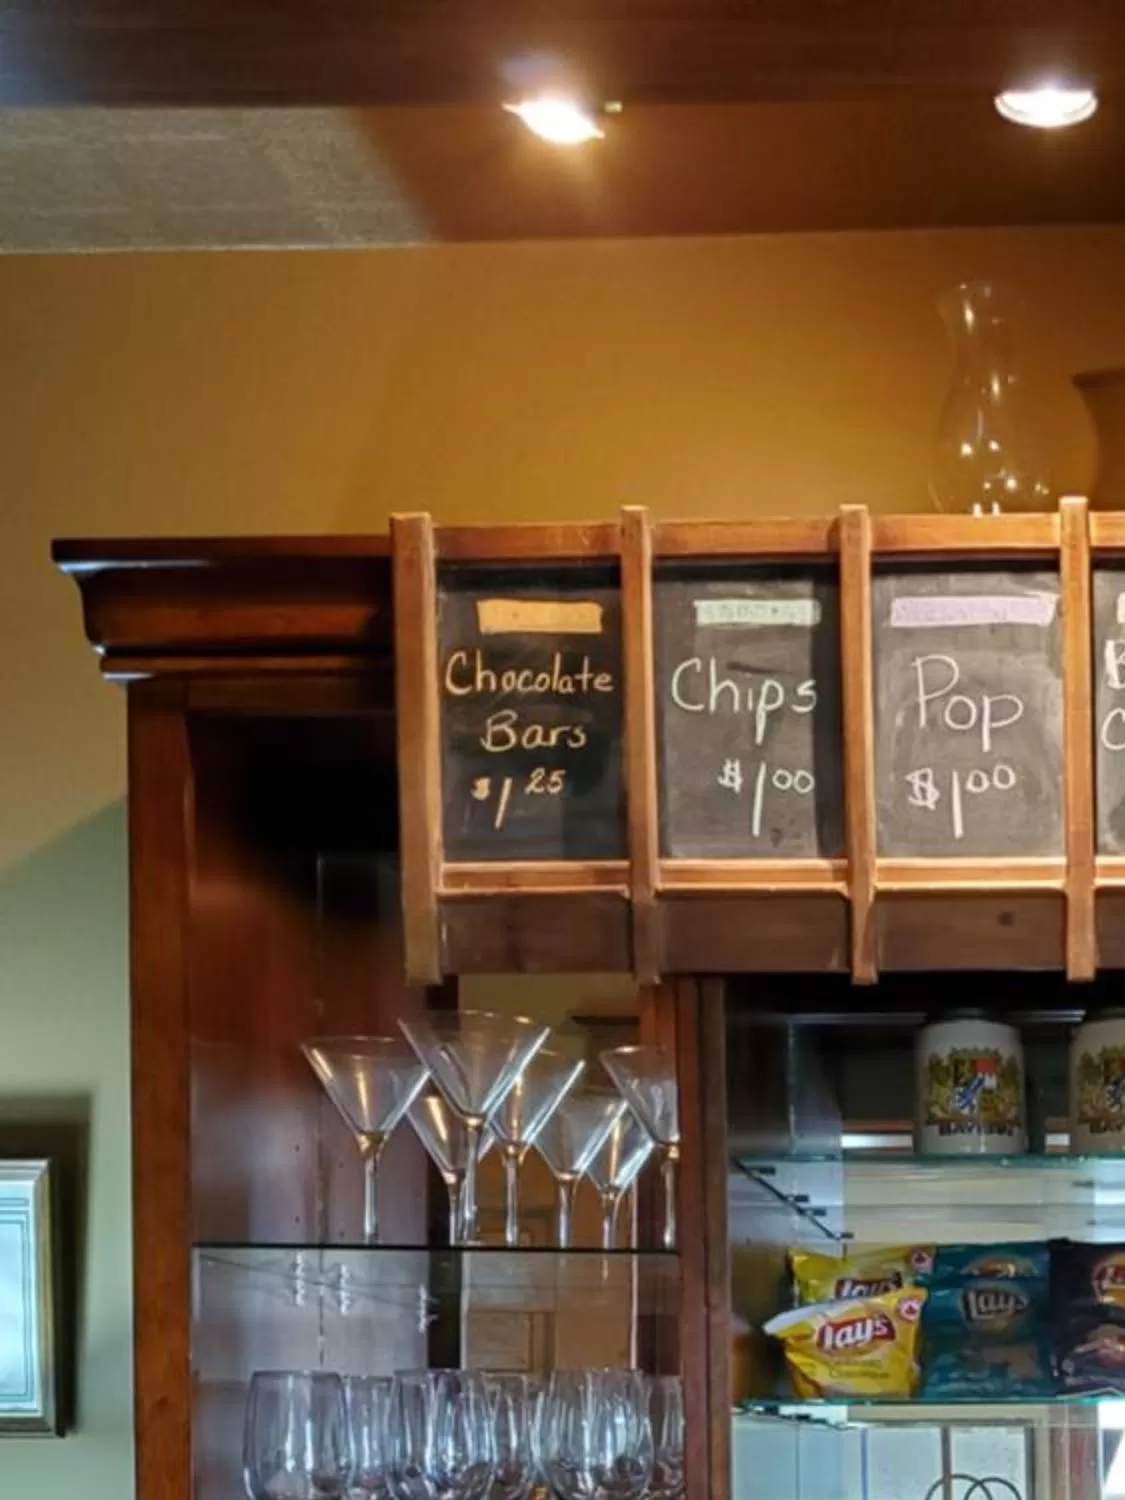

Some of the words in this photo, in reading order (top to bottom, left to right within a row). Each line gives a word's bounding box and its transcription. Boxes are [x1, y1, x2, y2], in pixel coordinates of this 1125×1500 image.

[445, 652, 614, 695] Chocolate
[671, 658, 817, 745] Chips
[912, 654, 1023, 752] Pop
[480, 711, 587, 752] Bars
